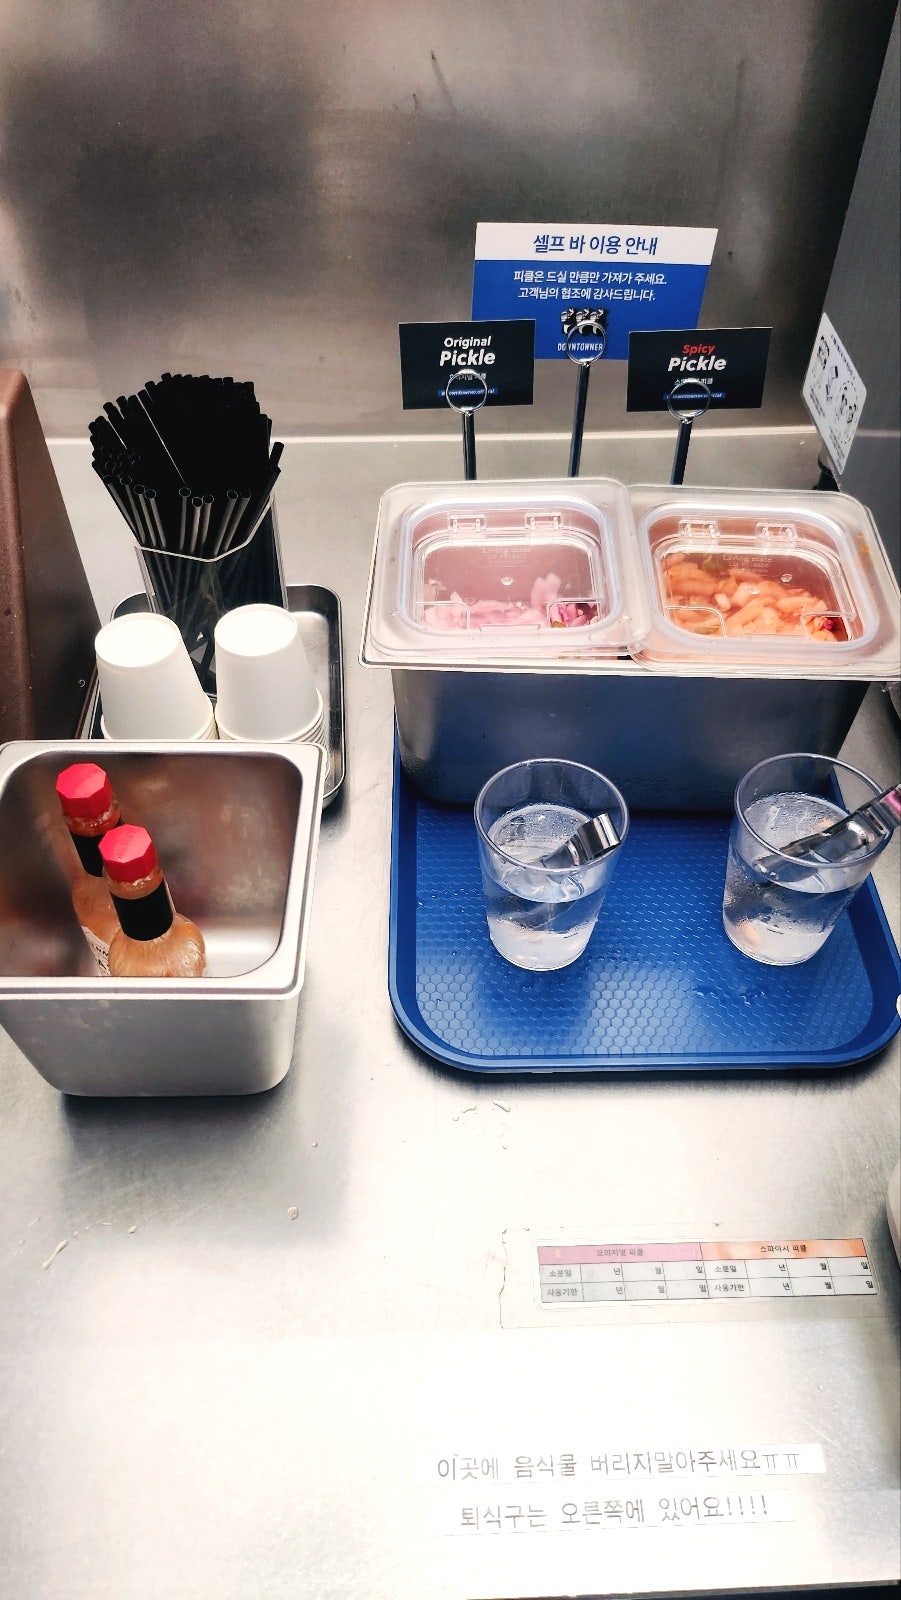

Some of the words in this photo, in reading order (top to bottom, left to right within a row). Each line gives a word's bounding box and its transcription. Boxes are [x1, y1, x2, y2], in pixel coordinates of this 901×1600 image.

[533, 234, 565, 254] 셀프
[569, 235, 585, 254] 바
[589, 235, 622, 255] 이용
[625, 236, 658, 256] 안내
[513, 270, 545, 283] 피클은
[547, 270, 566, 284] 드실
[569, 271, 600, 284] 만큼만
[601, 272, 632, 286] 가져가
[634, 273, 667, 286] 주세요.
[518, 287, 558, 300] 고객님의
[561, 287, 591, 300] 협조에
[593, 288, 656, 302] 감사드립니다.
[444, 336, 491, 350] Original
[682, 344, 716, 356] Spicy
[439, 349, 496, 367] Pickle
[667, 355, 727, 372] Pickle
[596, 1249, 627, 1257] 오리지널
[629, 1248, 644, 1257] 피클
[760, 1245, 790, 1254] 스파이시
[792, 1244, 807, 1253] 피클
[613, 1267, 621, 1276] 년
[696, 1265, 703, 1274] 일
[714, 1264, 737, 1273] 소분일
[778, 1263, 786, 1272] 년
[547, 1287, 578, 1297] 사용기한
[616, 1286, 624, 1295] 년
[699, 1284, 707, 1293] 일
[714, 1283, 744, 1292] 사용기한
[783, 1282, 790, 1291] 년
[437, 1453, 500, 1481] 이곳에
[513, 1453, 578, 1479] 음식물
[590, 1449, 801, 1476] 버리지말아주세요ㅠㅠ
[460, 1504, 547, 1529] 퇴식구는
[561, 1499, 646, 1526] 오른쪽에
[658, 1494, 768, 1522] 있어요!!!!
